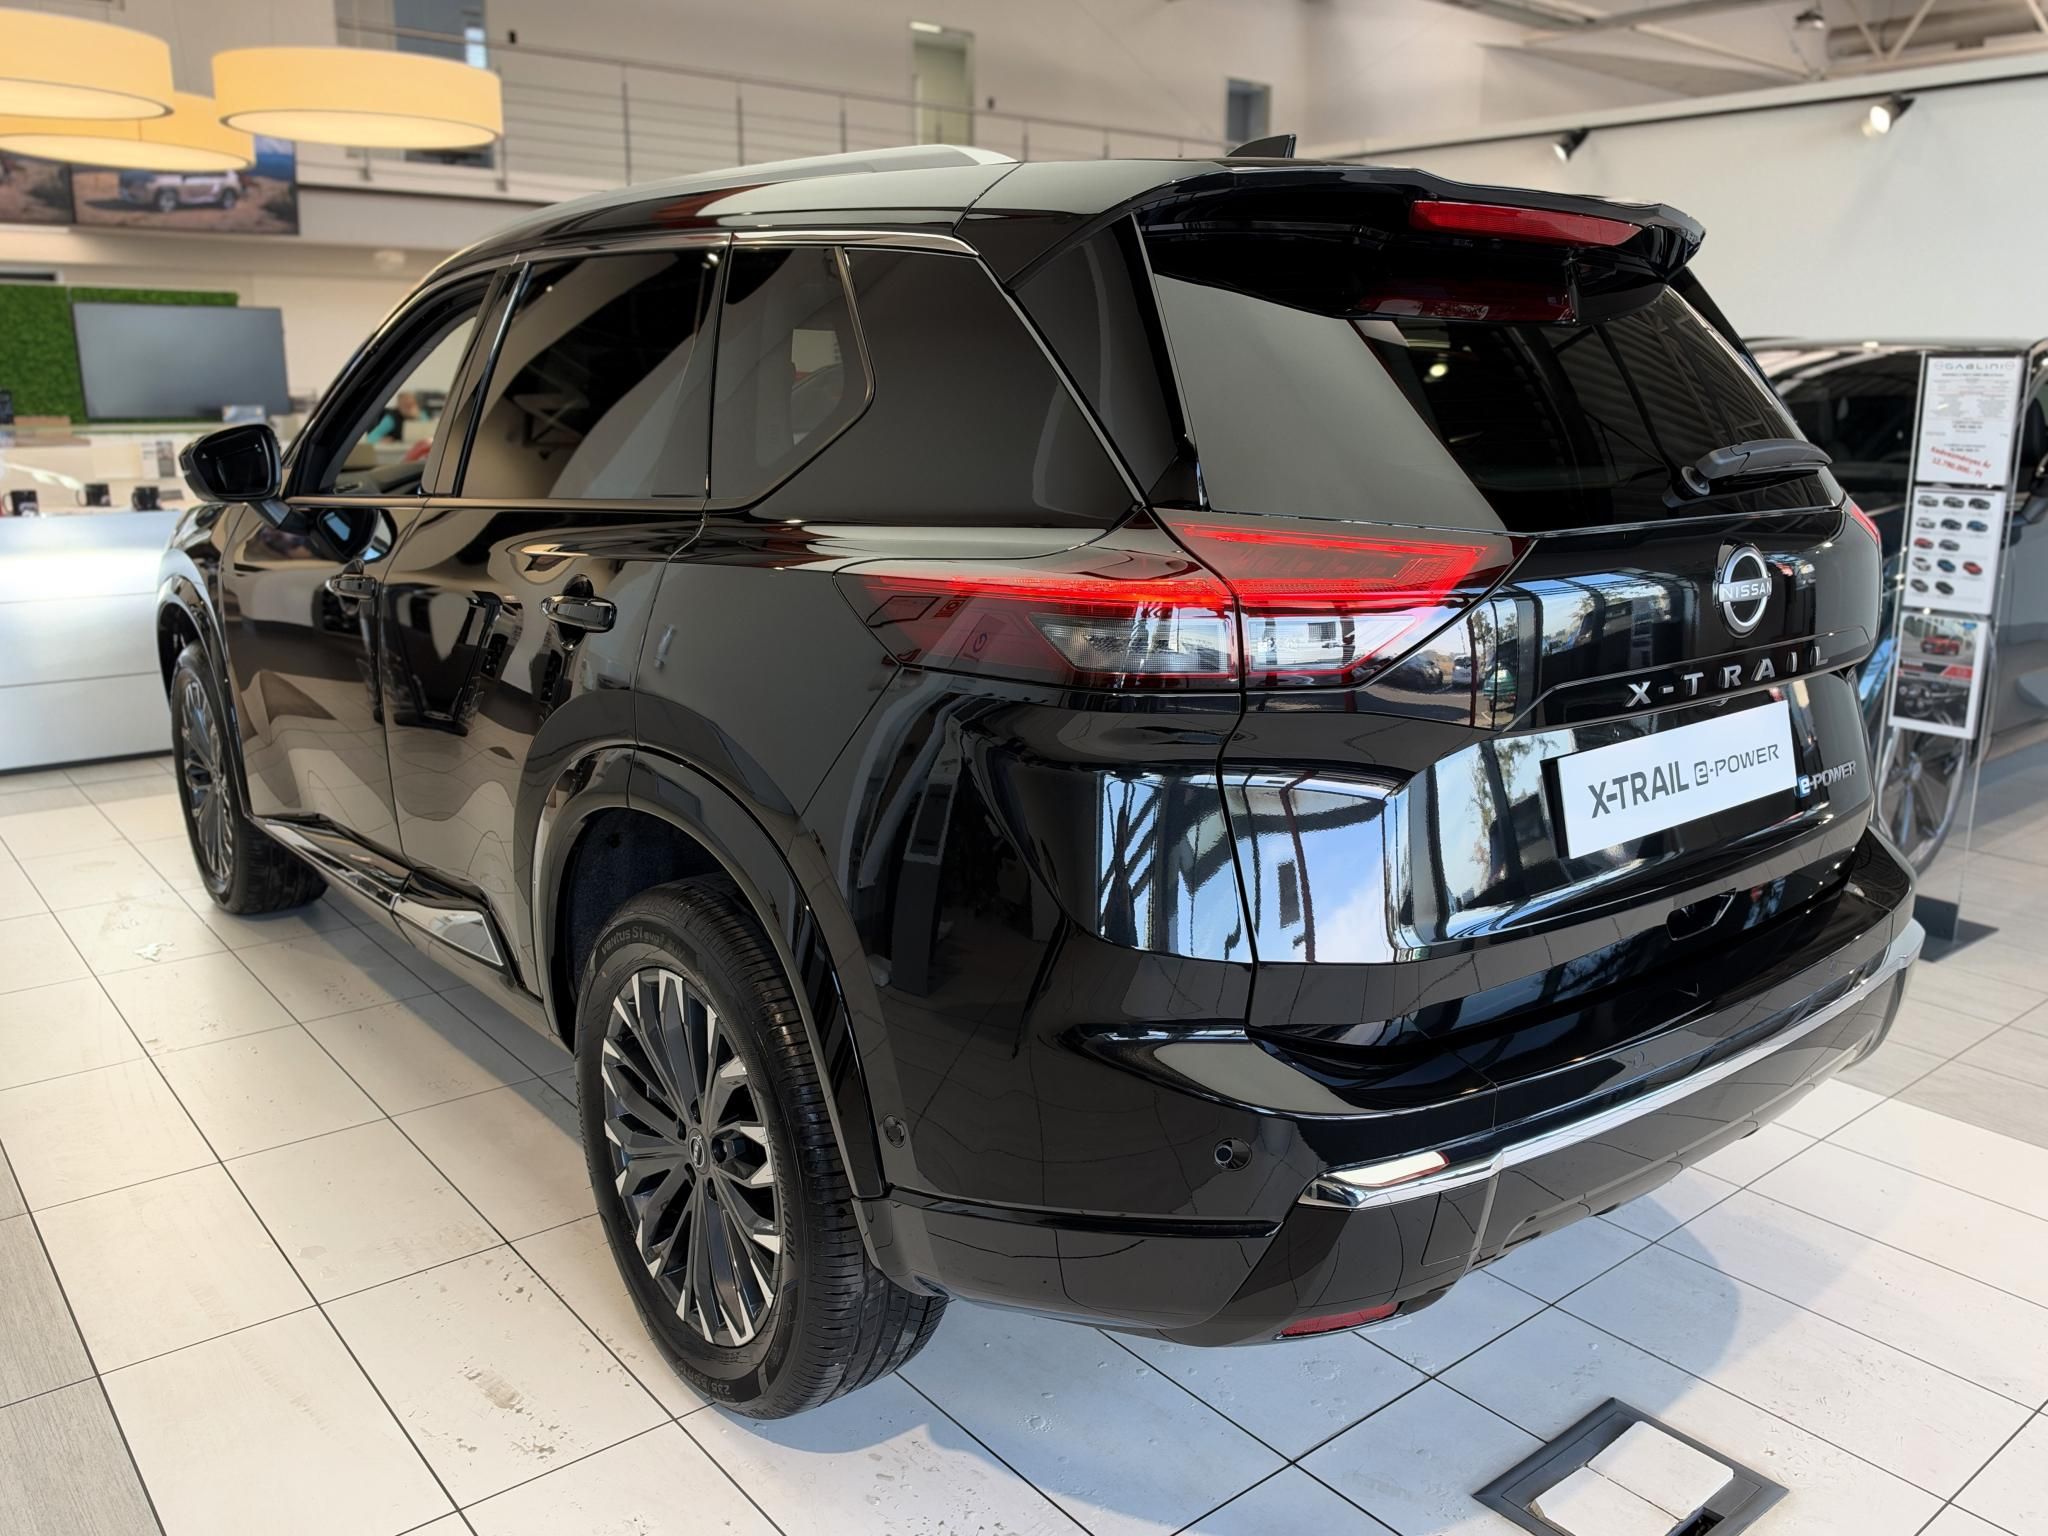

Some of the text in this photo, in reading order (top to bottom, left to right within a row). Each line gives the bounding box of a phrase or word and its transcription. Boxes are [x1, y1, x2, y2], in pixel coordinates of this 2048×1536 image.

[1721, 581, 1772, 599] NISSAN
[1625, 646, 1829, 707] X-TRAIL
[1588, 760, 1690, 819] X-TRAIL
